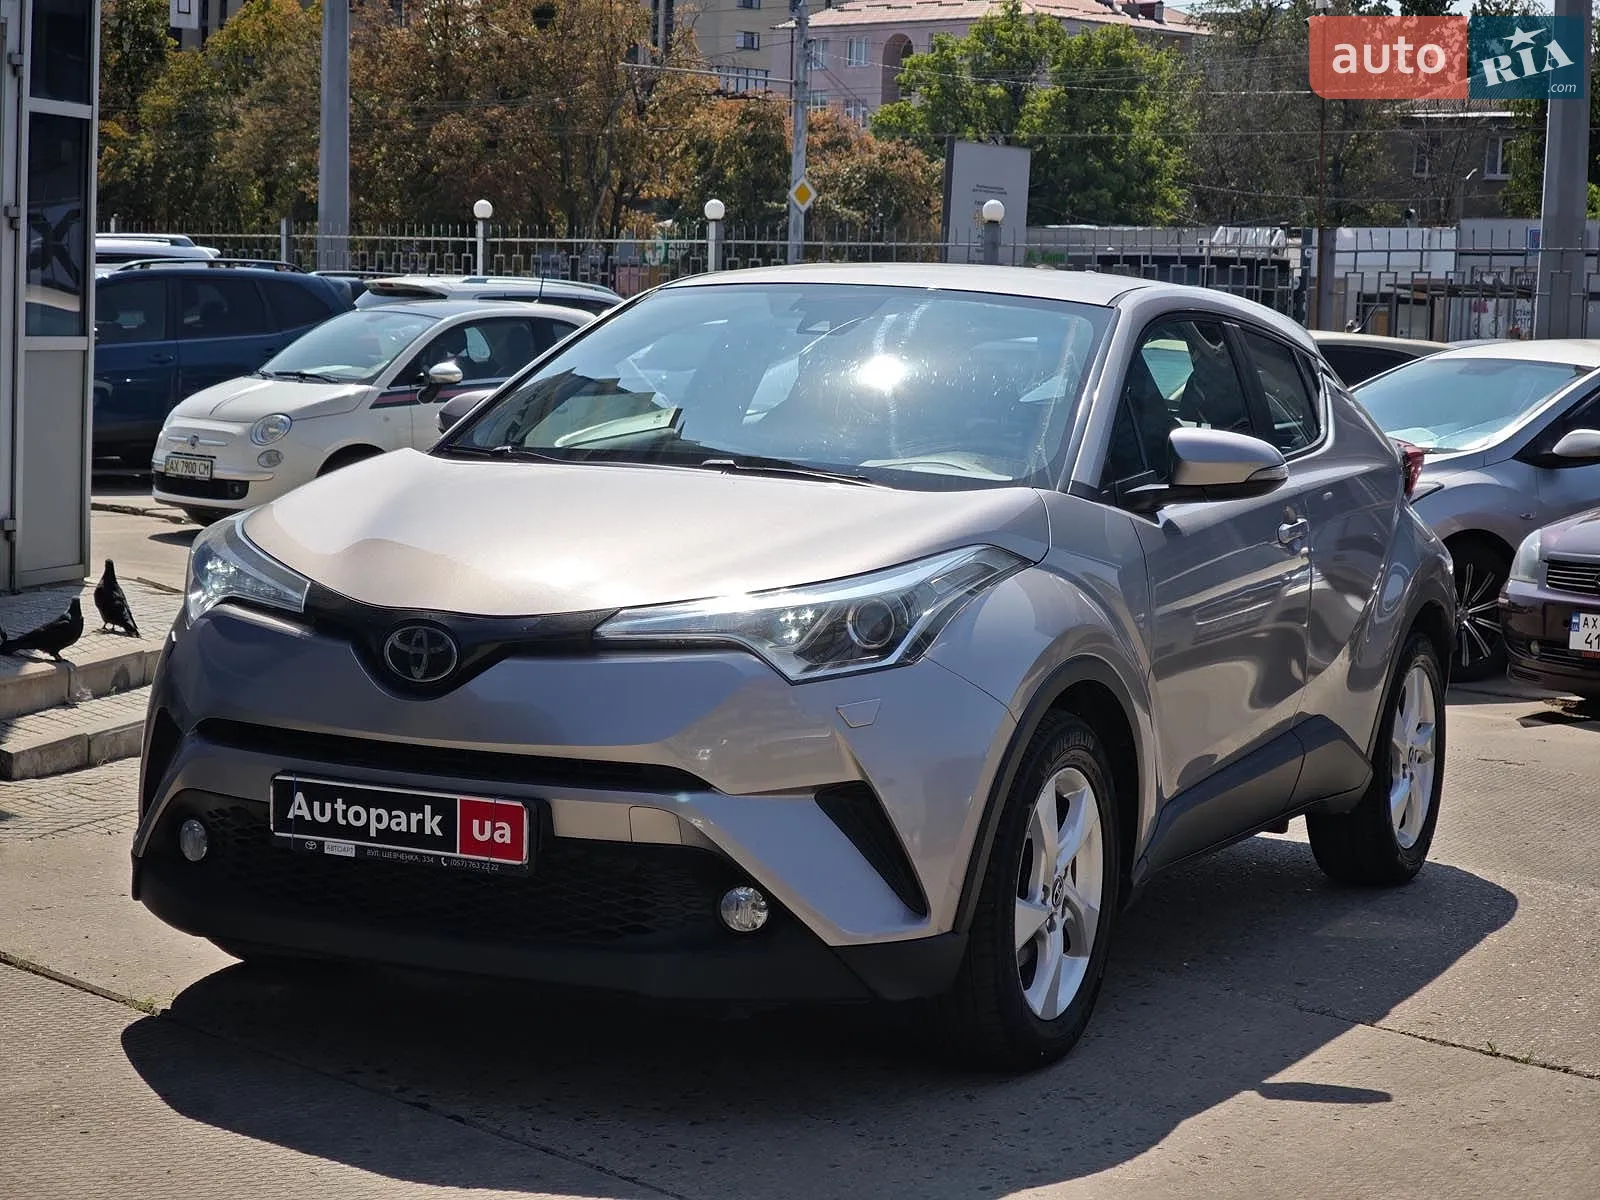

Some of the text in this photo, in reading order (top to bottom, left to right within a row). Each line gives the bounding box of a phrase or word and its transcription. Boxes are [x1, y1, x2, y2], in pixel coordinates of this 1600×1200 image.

[180, 460, 197, 474] 7900
[1582, 617, 1598, 629] AX
[286, 791, 444, 838] Autopark
[472, 819, 512, 844] ua
